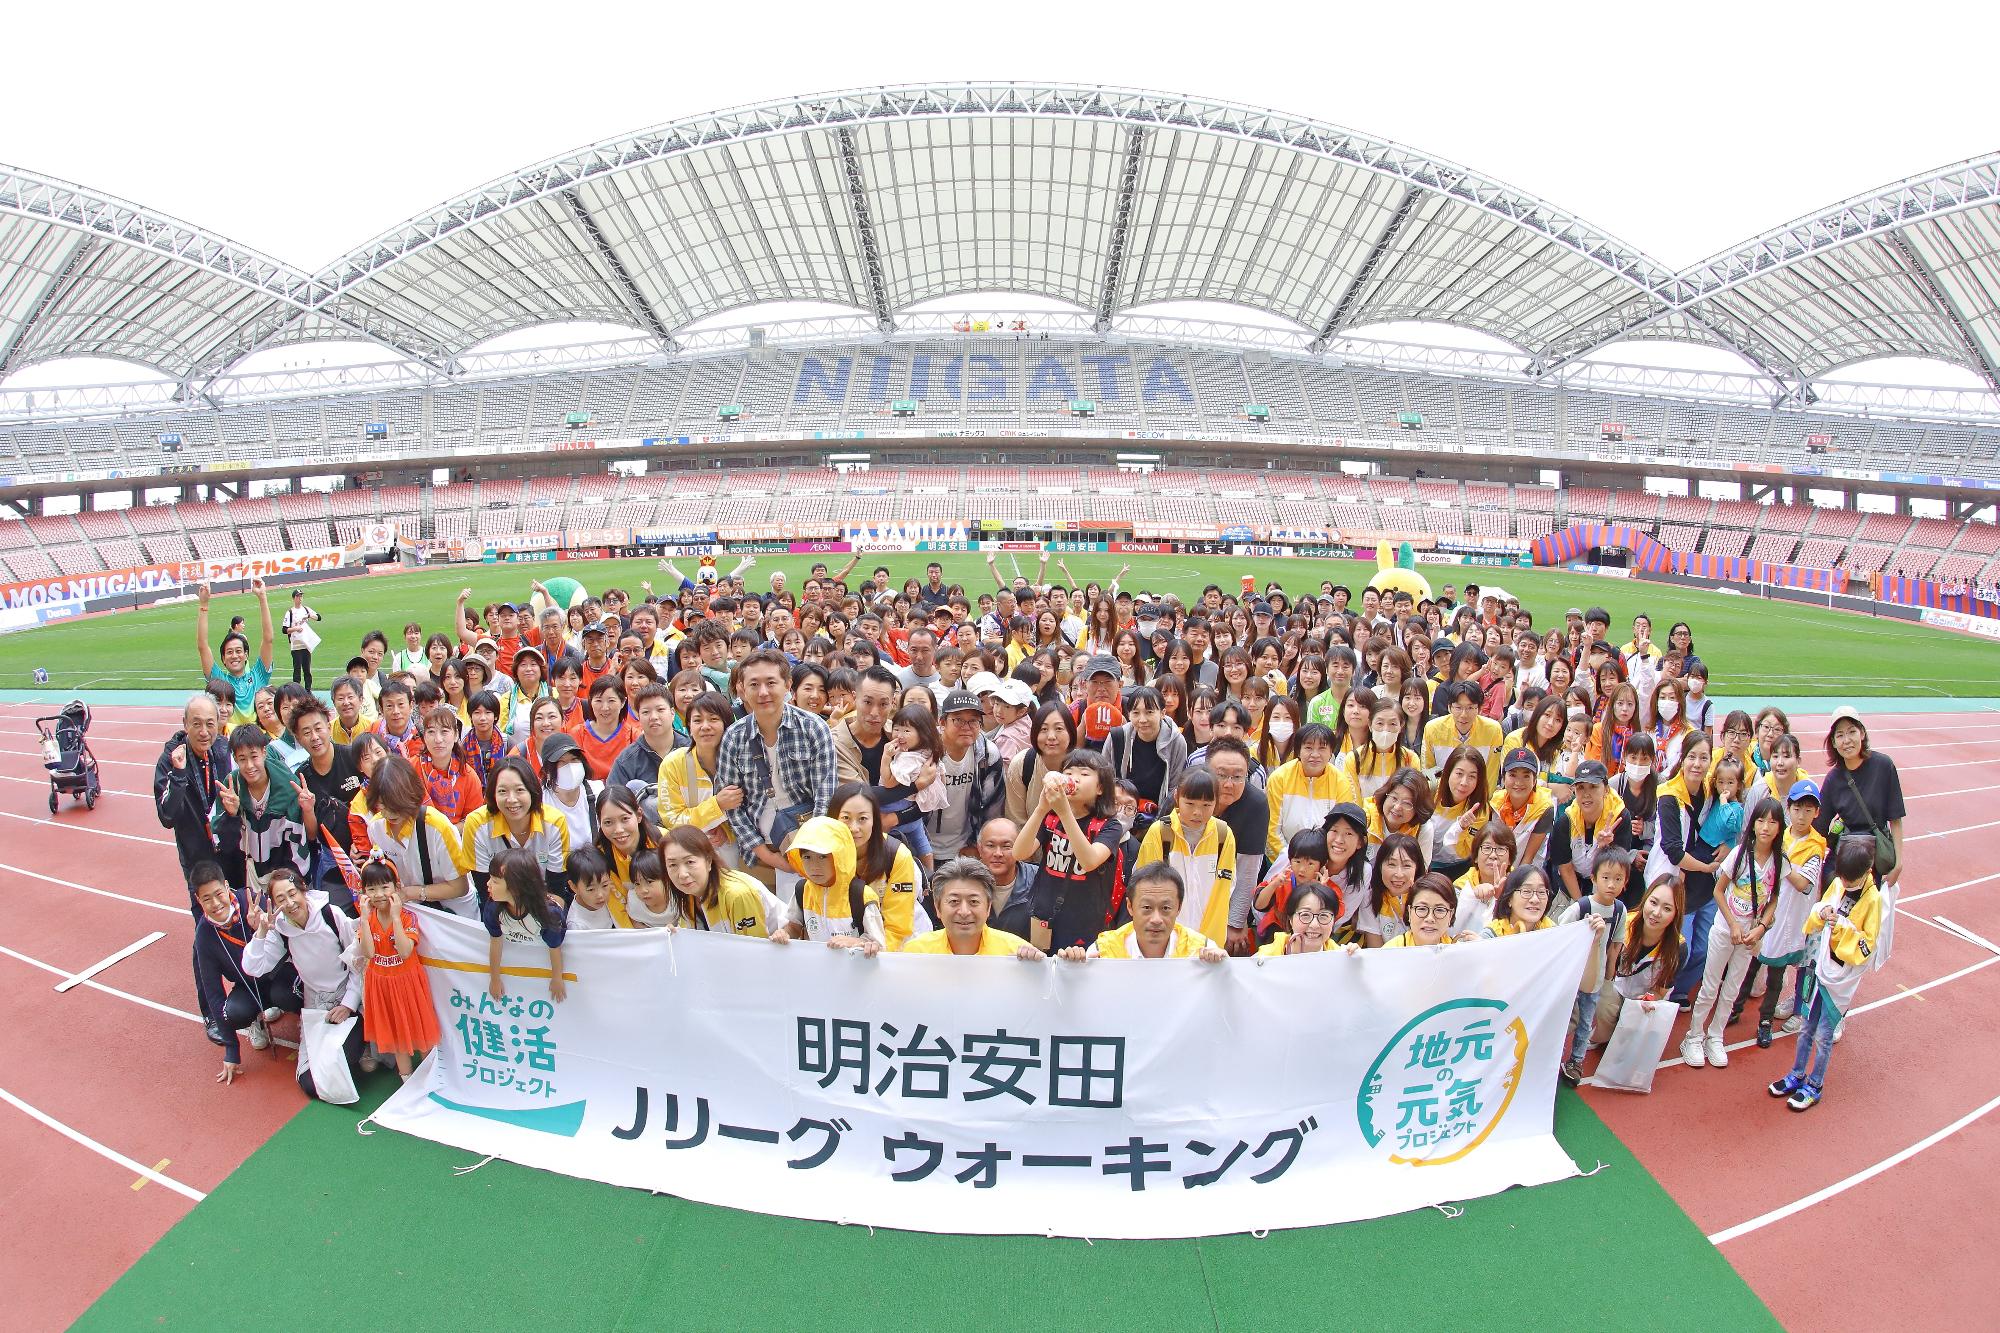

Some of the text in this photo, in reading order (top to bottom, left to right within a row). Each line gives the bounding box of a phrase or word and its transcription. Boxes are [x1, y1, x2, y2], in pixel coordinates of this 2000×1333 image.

[795, 354, 1195, 402] NIIGATA
[313, 456, 353, 464] SHINRYO
[483, 535, 559, 549] COMRADES
[864, 543, 903, 551] docomo
[927, 542, 968, 551] 明治安田
[1056, 542, 1097, 552] 明治安田
[1121, 544, 1159, 552] KONAMI
[1189, 545, 1227, 554] いちご
[515, 553, 548, 562] 明治安田
[567, 550, 599, 559] KONAMI
[730, 546, 753, 554] ROUTE
[209, 552, 341, 578] アイシテルニイガタ
[1420, 554, 1451, 563] docomo
[1471, 556, 1502, 566] 明治安田
[67, 568, 177, 601] NIIGATA
[1097, 706, 1111, 724] 14
[450, 988, 555, 1021] みんなの
[455, 1013, 557, 1073] 健活
[1403, 1018, 1496, 1071] 地元
[796, 1016, 1126, 1109] 明治安田
[463, 1059, 557, 1099] プロジェクト
[1436, 1067, 1454, 1082] の
[1395, 1077, 1484, 1131] 元気
[611, 1086, 1319, 1192] Jリーグ ウォーキング
[1395, 1120, 1477, 1151] プロジェクト
